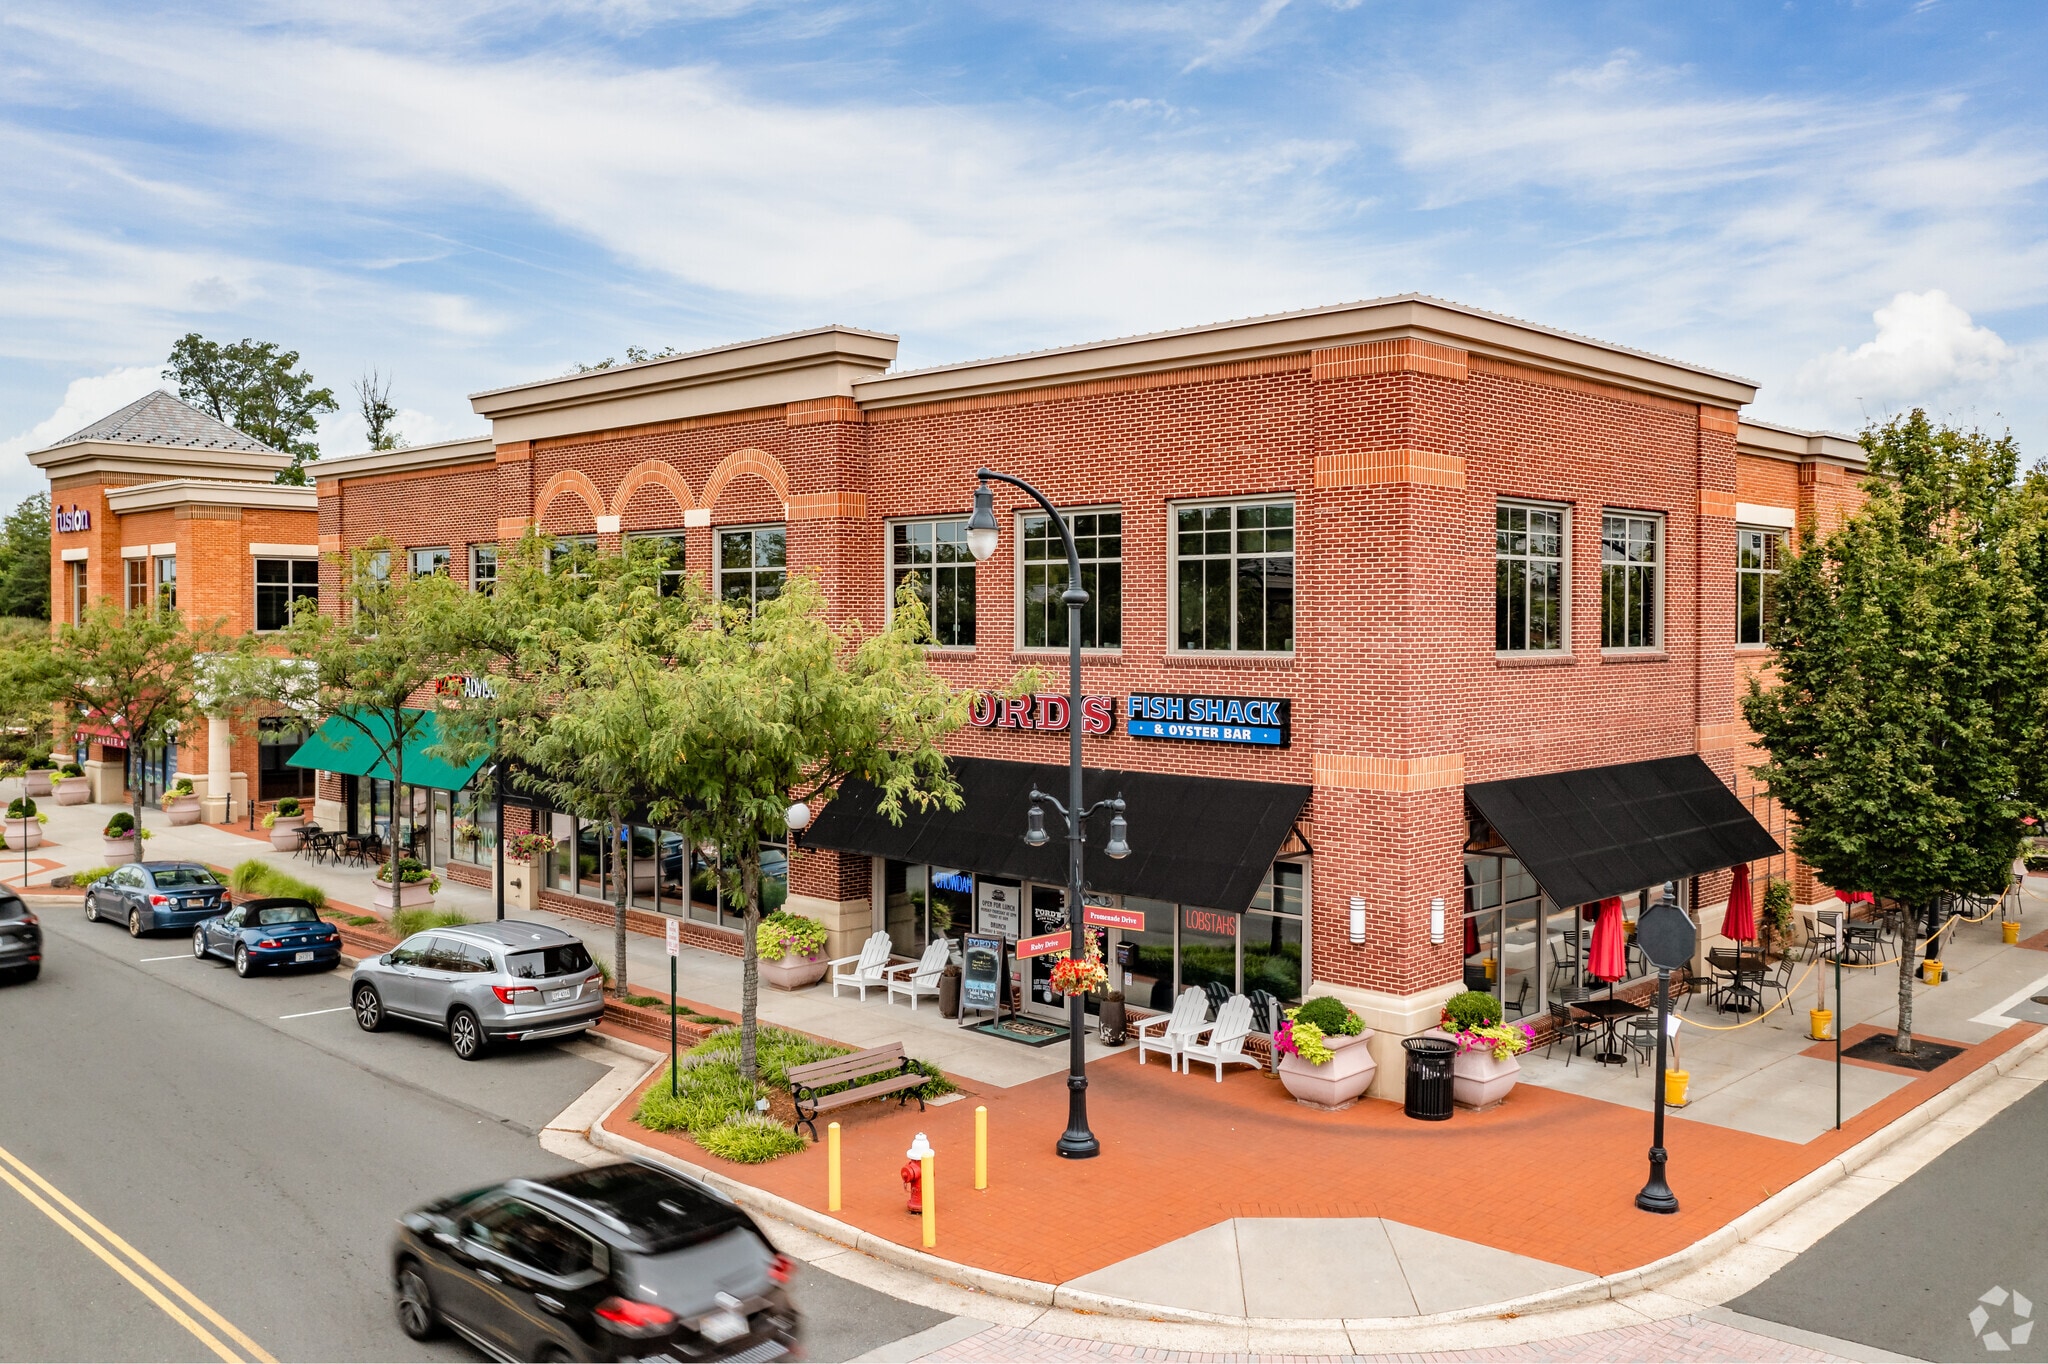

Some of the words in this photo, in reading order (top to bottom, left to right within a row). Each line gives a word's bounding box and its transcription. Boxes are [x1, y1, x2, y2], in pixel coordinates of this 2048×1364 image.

[56, 504, 90, 532] fusion
[1128, 695, 1184, 720] FISH
[1189, 698, 1281, 726] SHACK
[1154, 723, 1164, 735] &
[1168, 725, 1219, 739] OYSTER
[1223, 728, 1252, 741] BAR
[935, 872, 972, 894] CHOWDAH
[981, 900, 992, 908] OPEN
[1090, 912, 1120, 923] Promenade
[1121, 916, 1137, 925] Drive
[1186, 909, 1236, 936] LOBSTAHS
[1030, 943, 1044, 952] Ruby
[1045, 940, 1059, 949] Drive
